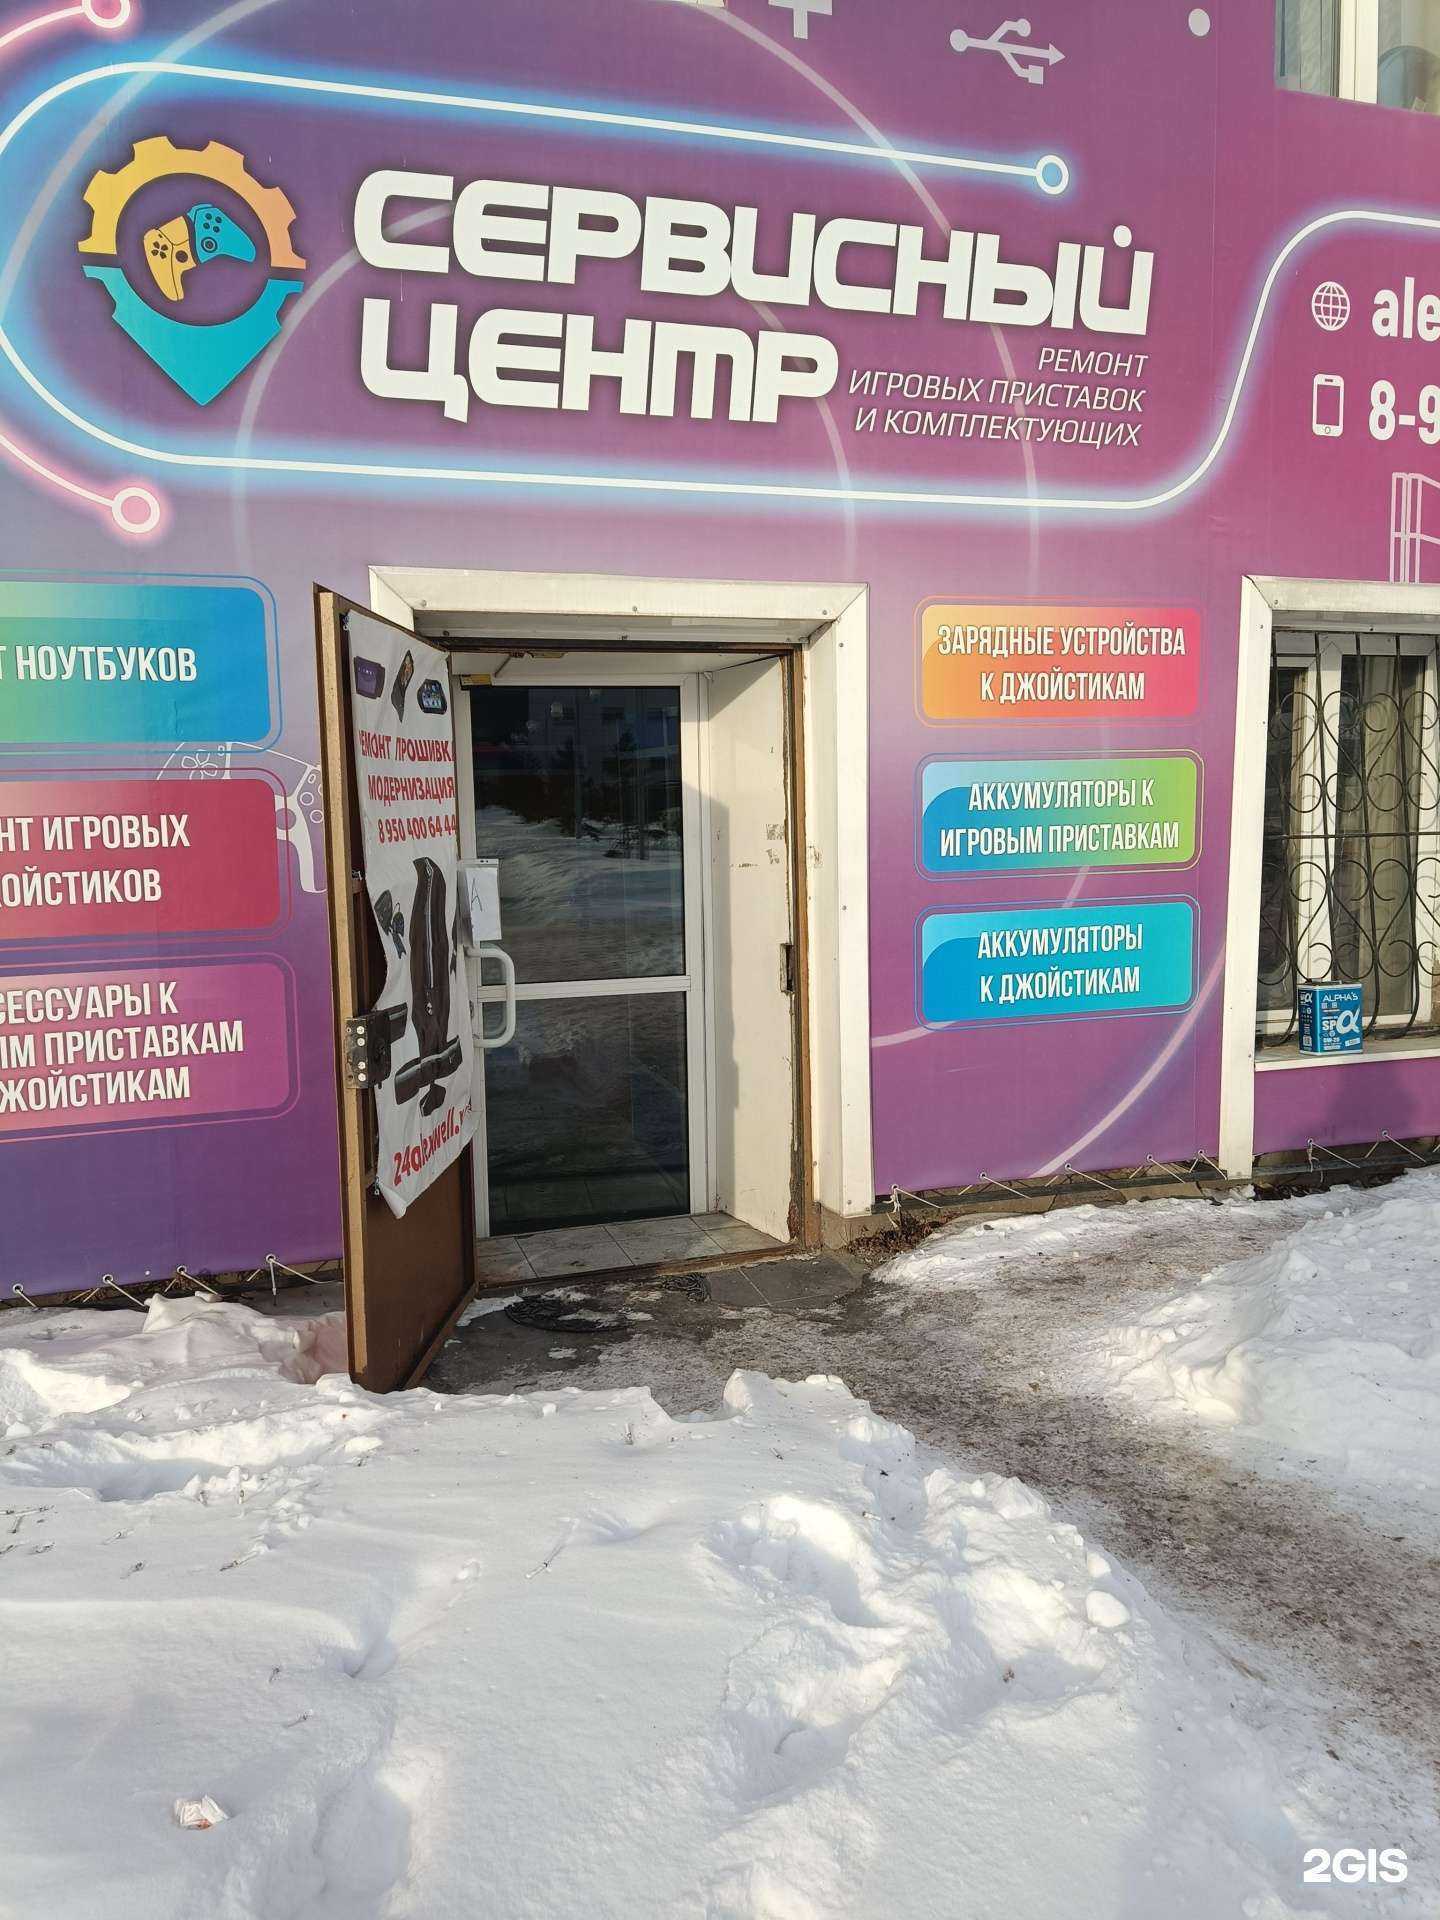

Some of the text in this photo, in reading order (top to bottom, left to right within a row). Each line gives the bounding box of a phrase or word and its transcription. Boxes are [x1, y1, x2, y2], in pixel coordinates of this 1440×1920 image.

[354, 170, 1154, 335] СЕРВИСНЫЙ
[1372, 276, 1440, 342] ale
[360, 298, 839, 424] ЦЕНТР
[1038, 347, 1148, 377] РЕМОНТ
[848, 369, 1146, 412] ИГРОВЫХ ПРИСТАВОК
[855, 407, 1142, 449] И КОМПЛЕКТУЮЩИХ
[1369, 379, 1440, 445] 8-9
[938, 621, 1186, 658] ЗАРЯДНЫЕ УСТРОЙСТВА
[15, 645, 198, 682] НОУТБУКОВ
[980, 666, 1145, 704] К ДЖОЙСТИКАМ
[359, 730, 391, 759] ЕМОНТ
[368, 774, 456, 806] МОДЕРНИЗАЦИЯ
[968, 778, 1154, 811] АККУМУЛЯТОРЫ К
[42, 814, 190, 851] ИГРОВЫХ
[378, 818, 385, 843] 8
[385, 818, 406, 842] 950
[407, 816, 427, 840] 400
[428, 816, 442, 838] 64
[940, 821, 1179, 857] ИГРОВЫМ ПРИСТАВКАМ
[0, 865, 162, 908] ОЙСТИКОВ
[977, 923, 1142, 959] АККУМУЛЯТОРЫ
[158, 982, 178, 1015] К
[980, 965, 1140, 1005] К ДЖОЙСТИКАМ
[44, 1020, 244, 1066] ПРИСТАВКАМ
[0, 1066, 191, 1113] ЖОЙСТИКАМ
